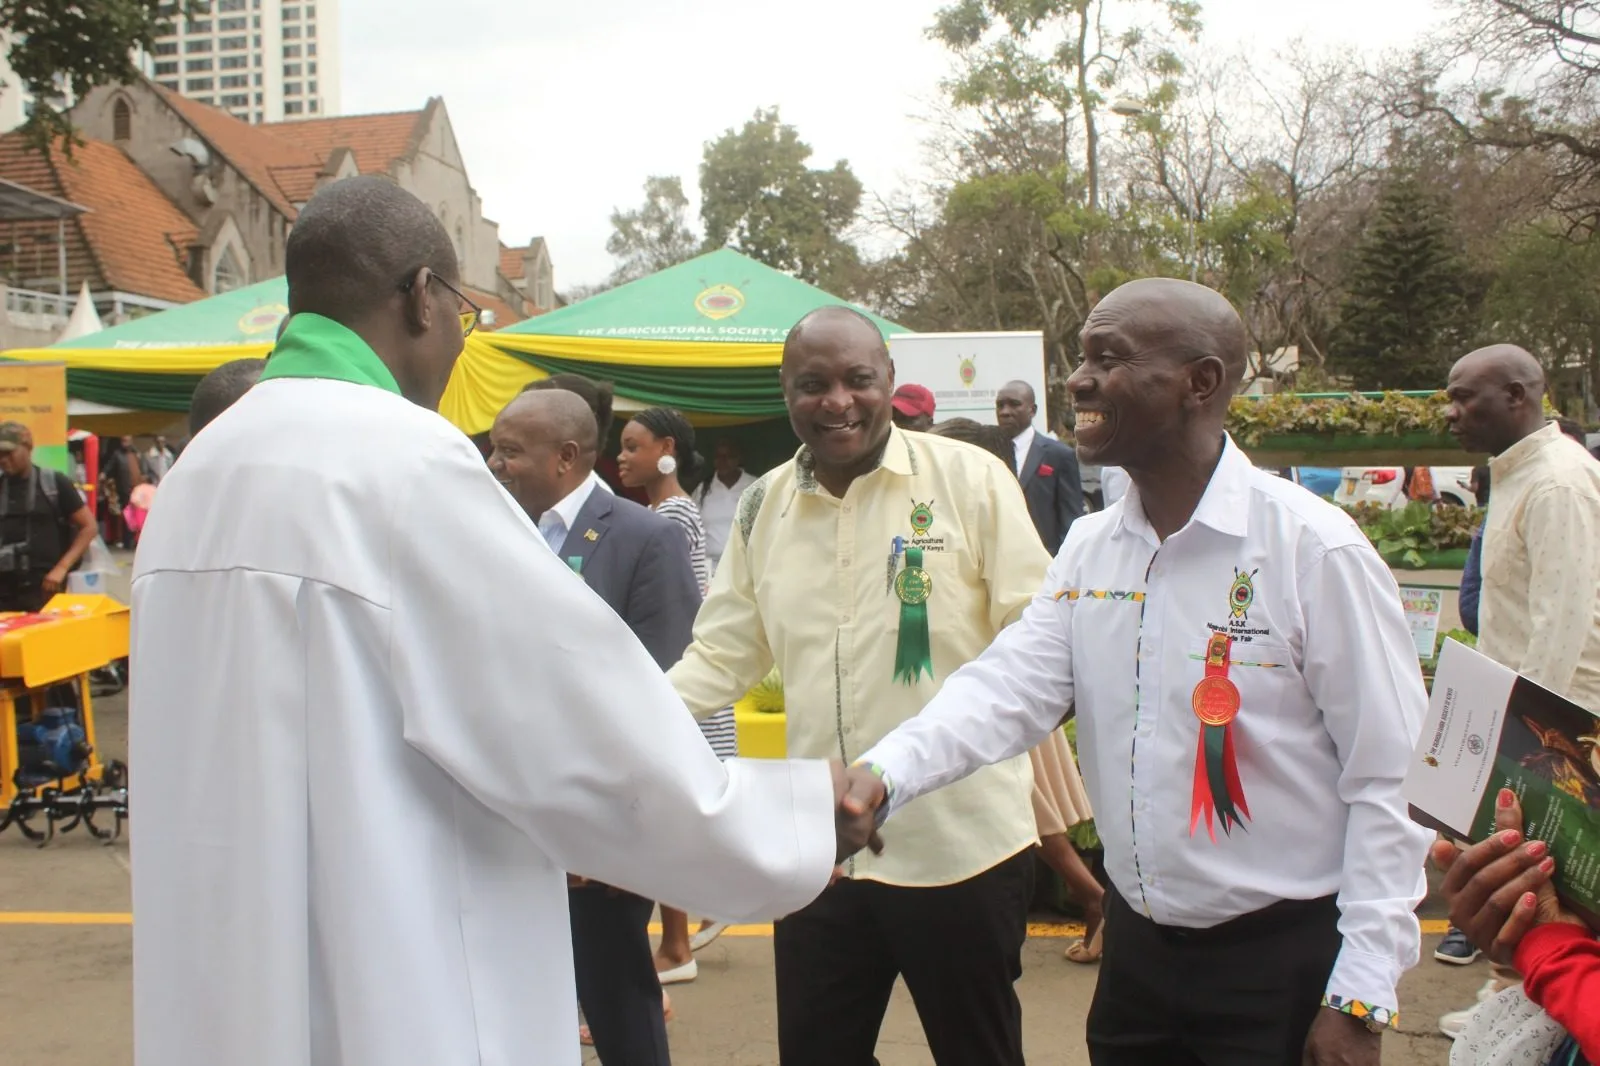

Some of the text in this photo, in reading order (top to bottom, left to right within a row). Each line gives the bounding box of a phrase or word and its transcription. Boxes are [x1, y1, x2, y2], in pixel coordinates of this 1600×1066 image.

[577, 328, 604, 336] THE
[607, 326, 713, 336] AGRICULTURAL
[718, 326, 778, 336] SOCIETY
